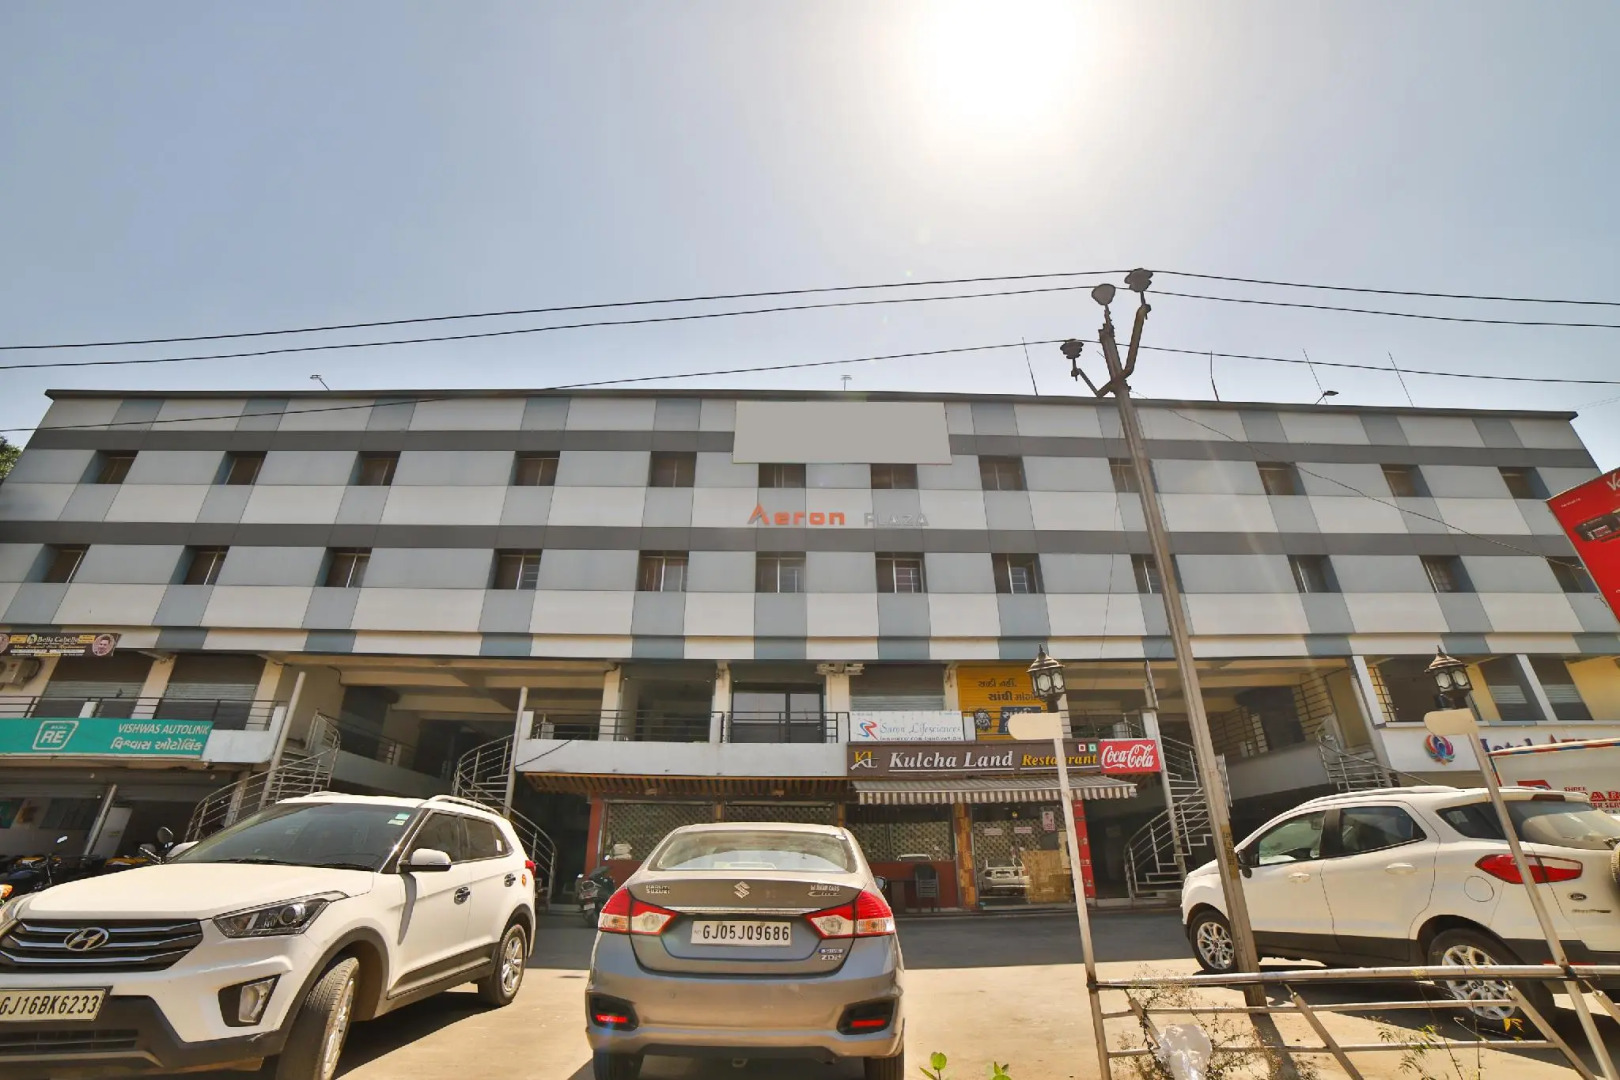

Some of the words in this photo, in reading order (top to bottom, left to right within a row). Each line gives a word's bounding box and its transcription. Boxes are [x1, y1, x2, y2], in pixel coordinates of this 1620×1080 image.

[748, 503, 845, 525] Aeron
[864, 512, 930, 527] PLAZA
[40, 731, 66, 744] RE
[118, 723, 161, 734] VISHWAS
[163, 724, 211, 735] AUTOLINK
[888, 751, 957, 768] Kulcha
[963, 750, 1013, 767] Land
[1021, 753, 1097, 766] Restarant
[1101, 744, 1154, 769] Coca-Cola
[703, 925, 789, 941] GJ05JQ9686
[0, 995, 99, 1015] GJ16BK6233
